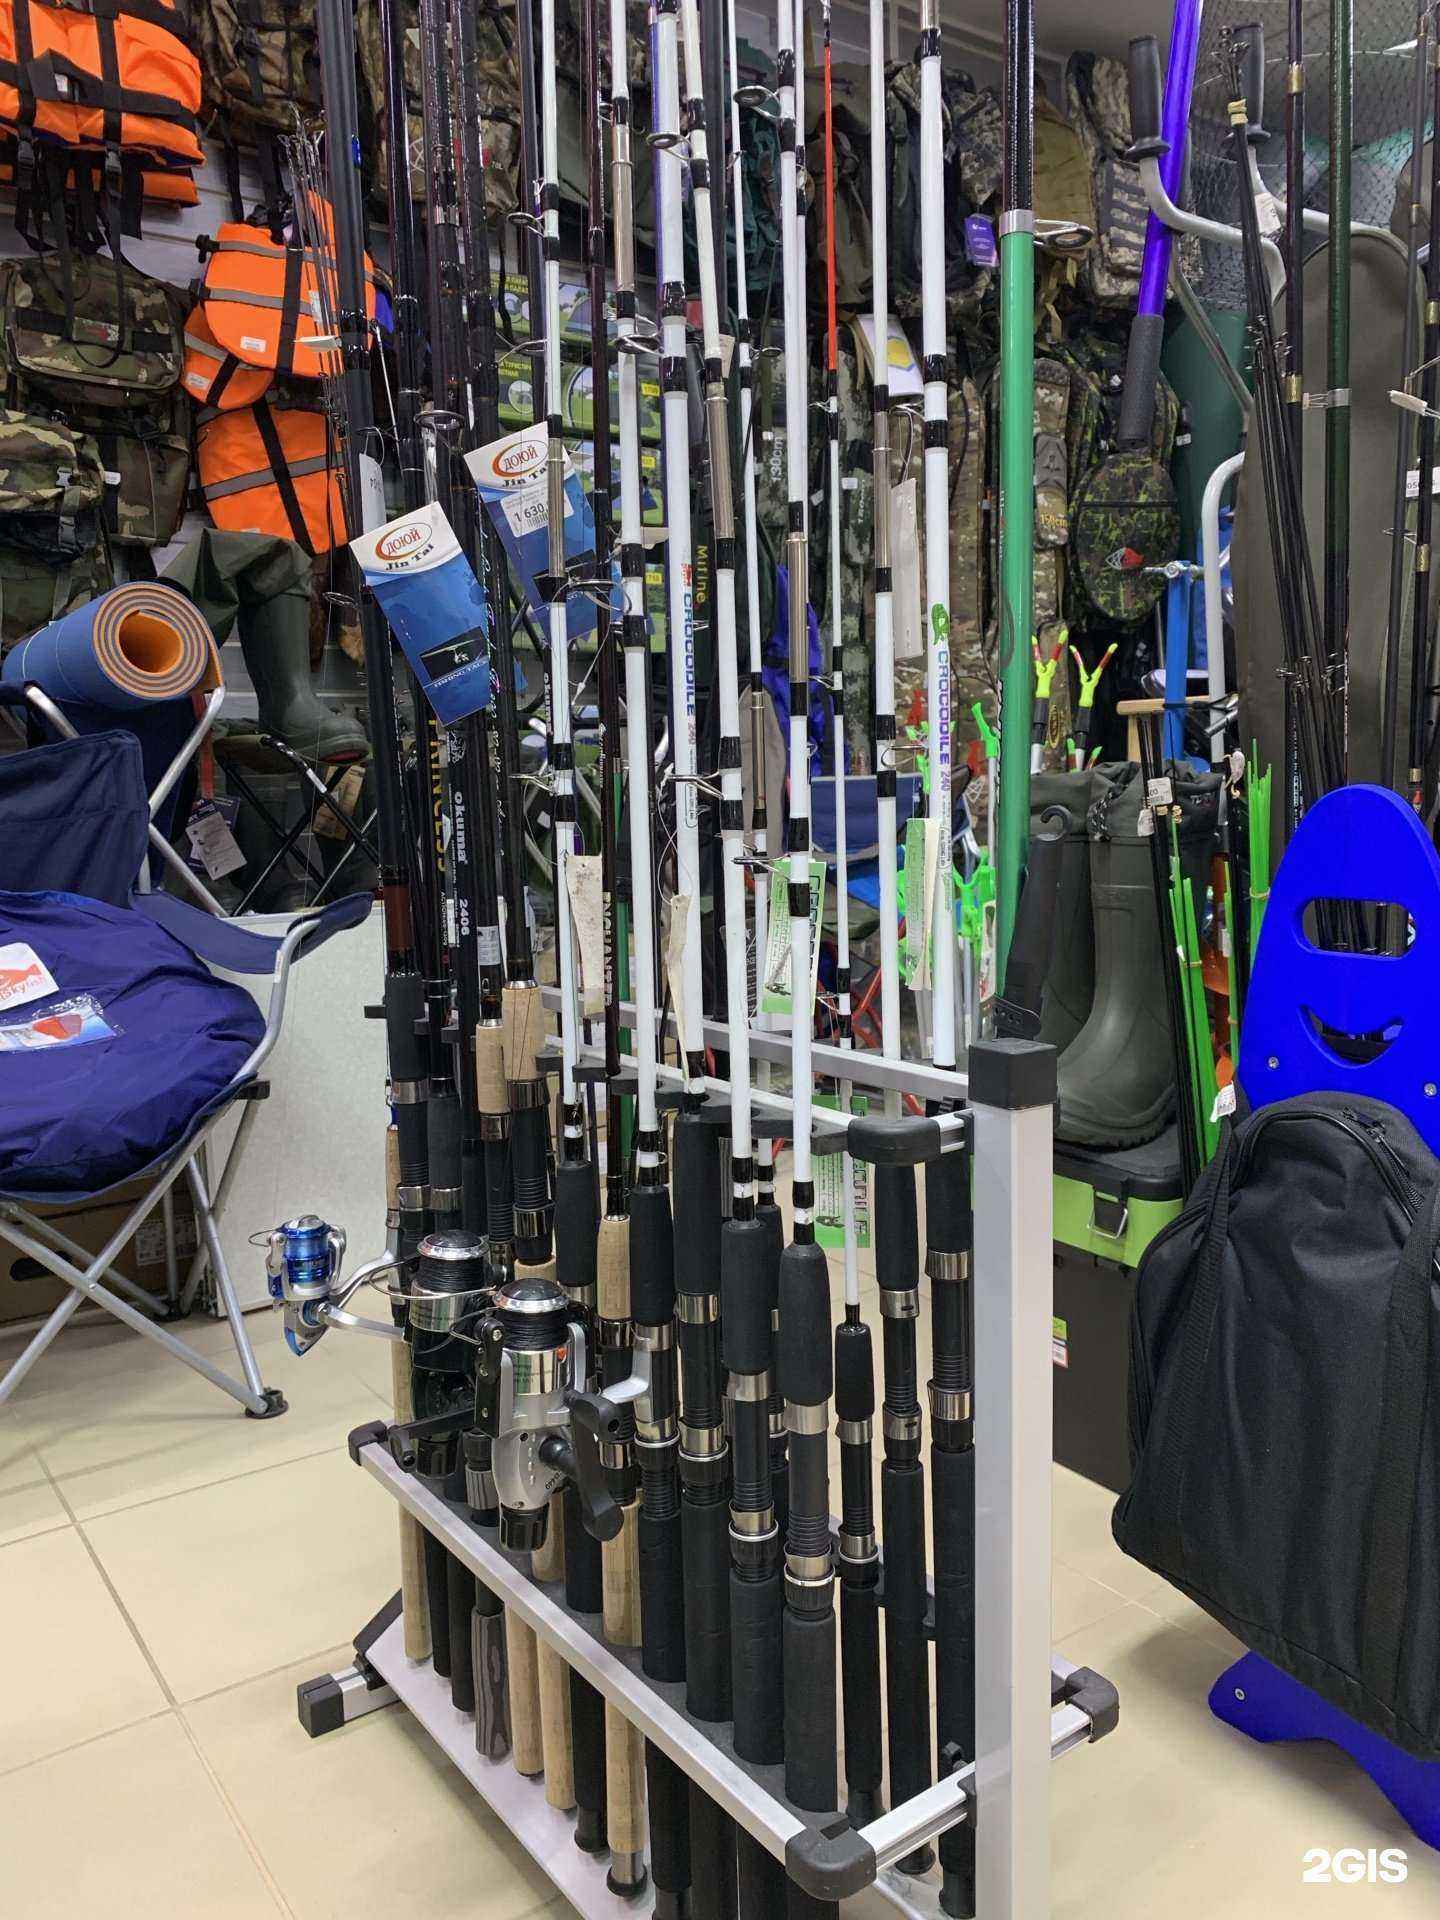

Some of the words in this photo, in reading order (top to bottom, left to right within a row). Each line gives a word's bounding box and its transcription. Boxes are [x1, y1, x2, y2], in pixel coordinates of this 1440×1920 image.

[504, 444, 539, 472] ДОЮЙ
[502, 477, 526, 488] Jin
[385, 527, 422, 556] ДОЮЙ
[385, 560, 409, 571] Jin
[683, 592, 696, 717] CROCODILE
[938, 649, 950, 766] CROCODILE
[454, 791, 468, 864] okuma
[459, 899, 470, 936] 2406
